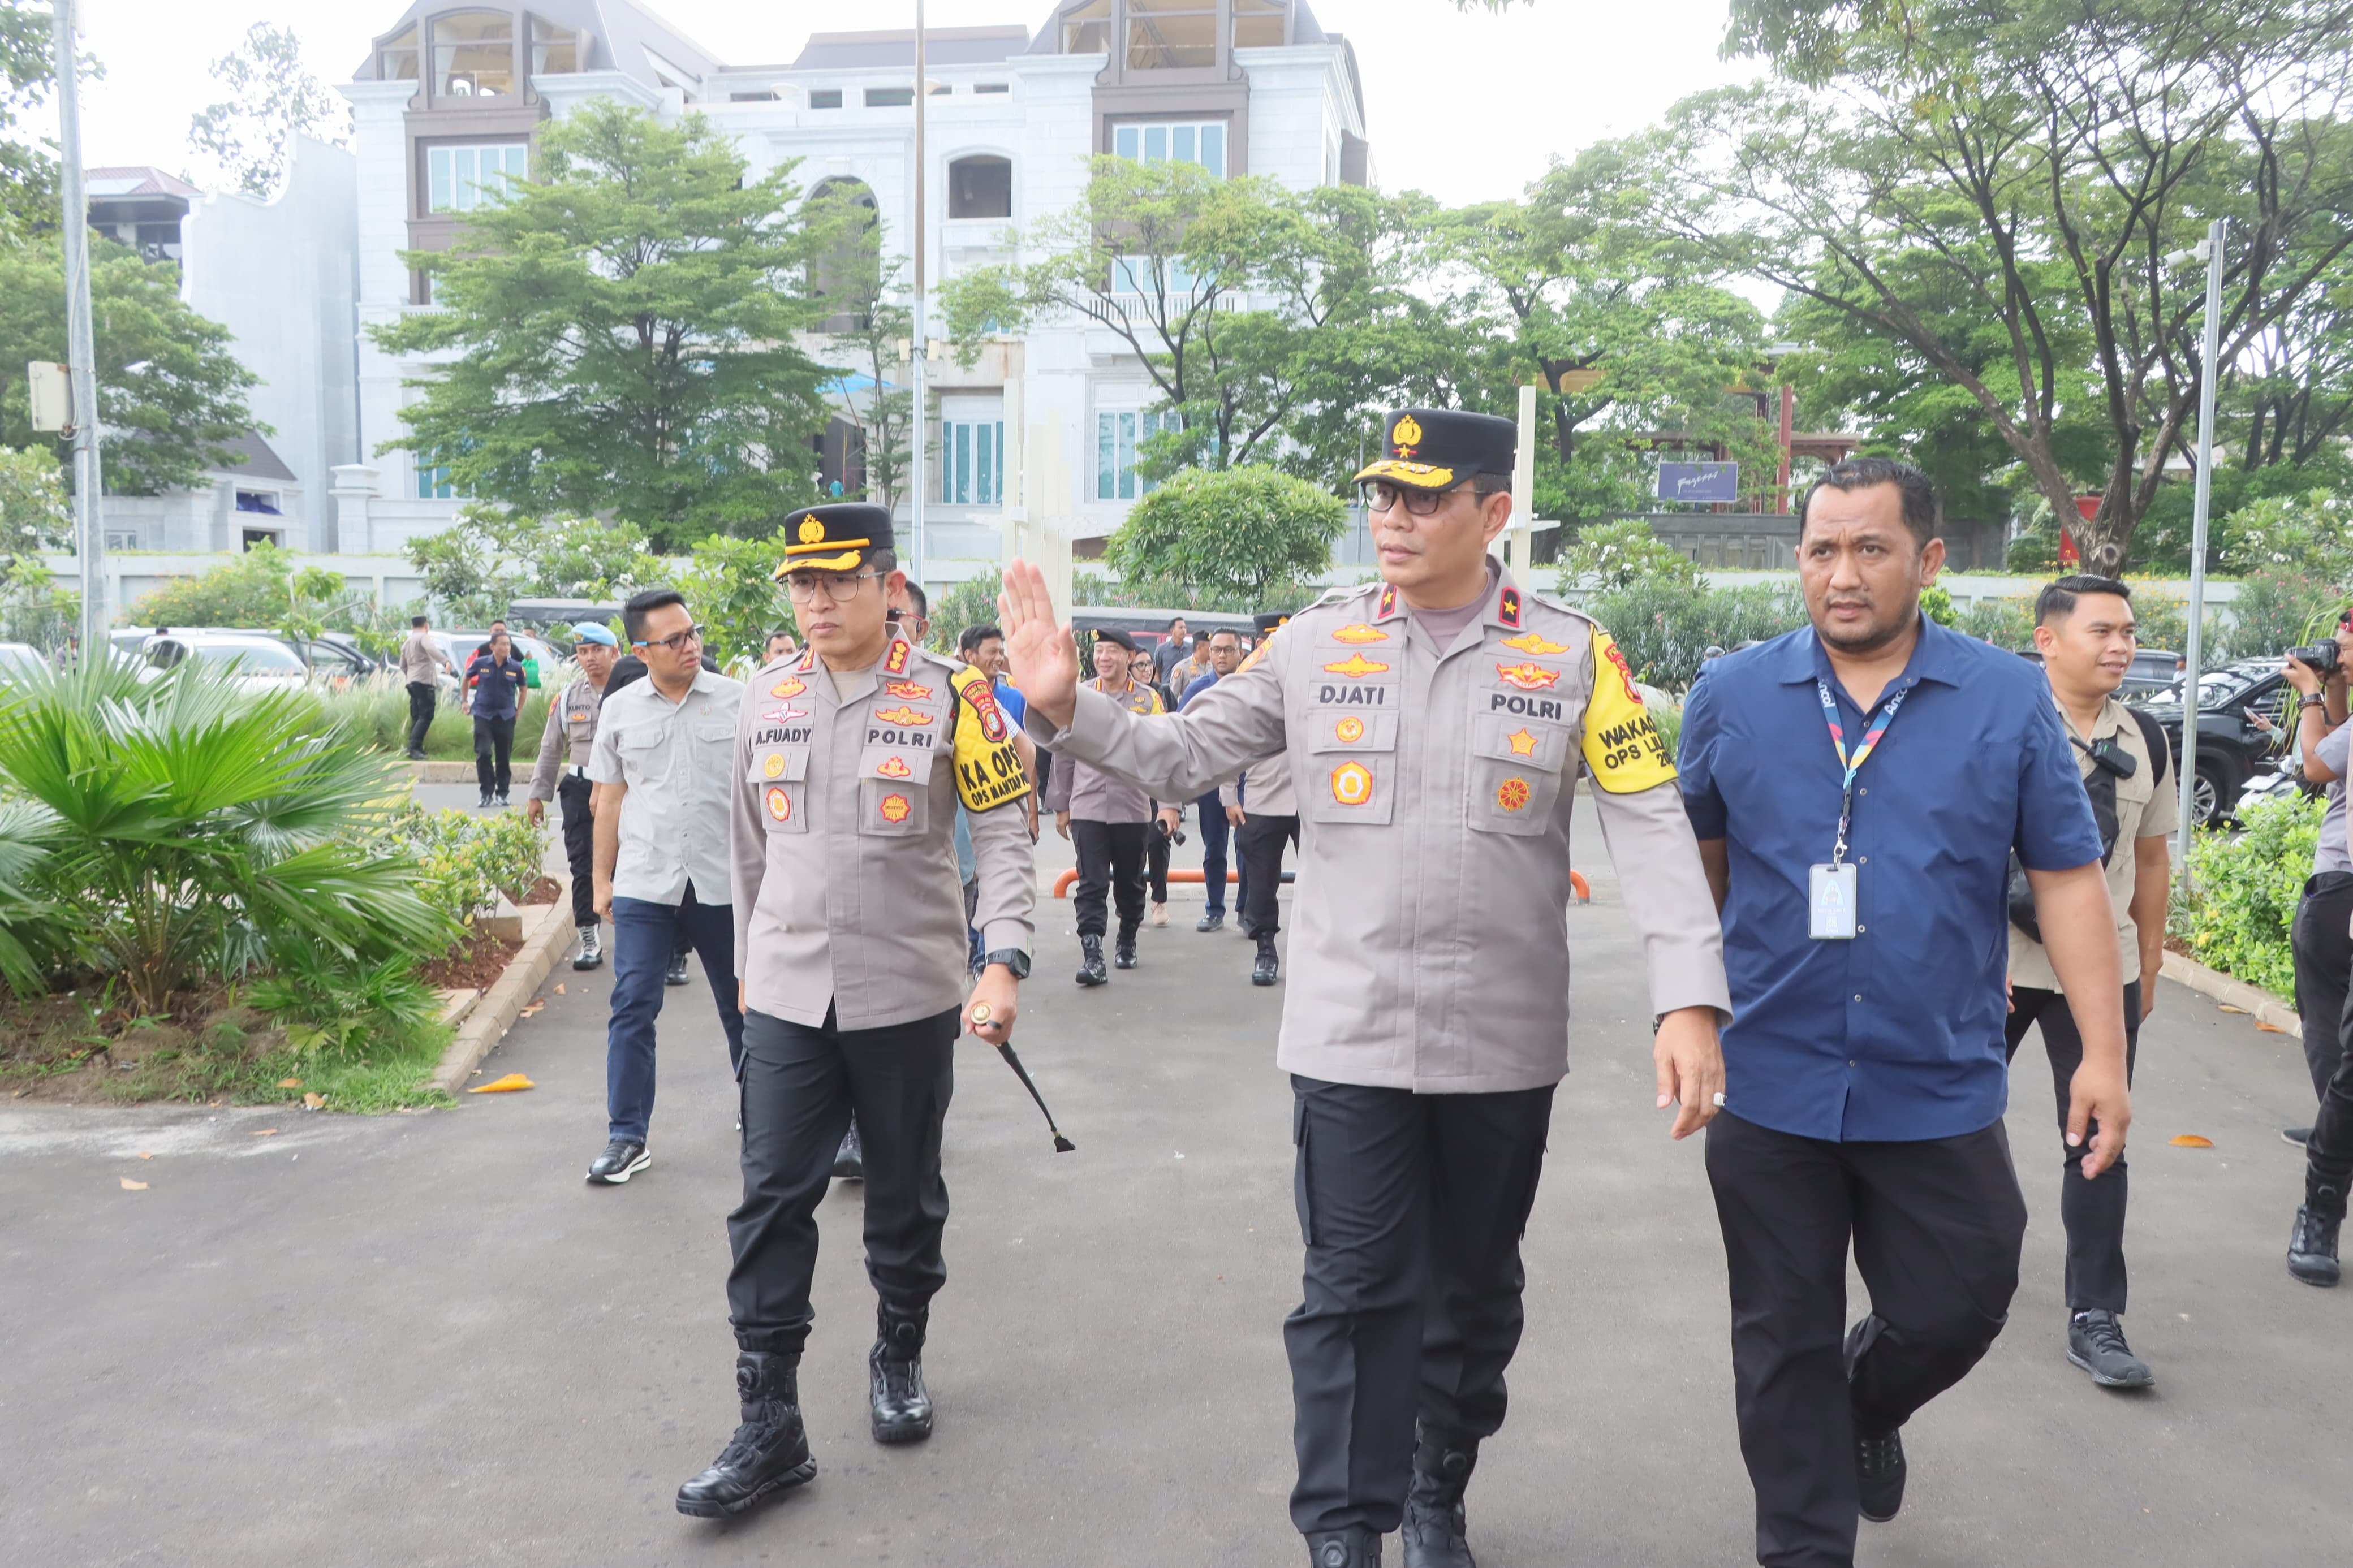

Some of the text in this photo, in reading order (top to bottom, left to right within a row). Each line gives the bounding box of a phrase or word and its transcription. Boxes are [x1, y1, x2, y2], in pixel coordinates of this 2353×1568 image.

[1320, 685, 1385, 705] DJATI
[1491, 693, 1561, 720] POLRI
[1818, 683, 1836, 708] ncol
[756, 728, 811, 745] A.FUADY
[868, 729, 932, 748] POLRI
[1598, 715, 1657, 749] WAKAO
[959, 759, 990, 791] KA
[992, 744, 1022, 778] OPS
[1605, 744, 1641, 769] OPS
[971, 789, 990, 806] OPS
[990, 775, 1022, 800] MANTAP
